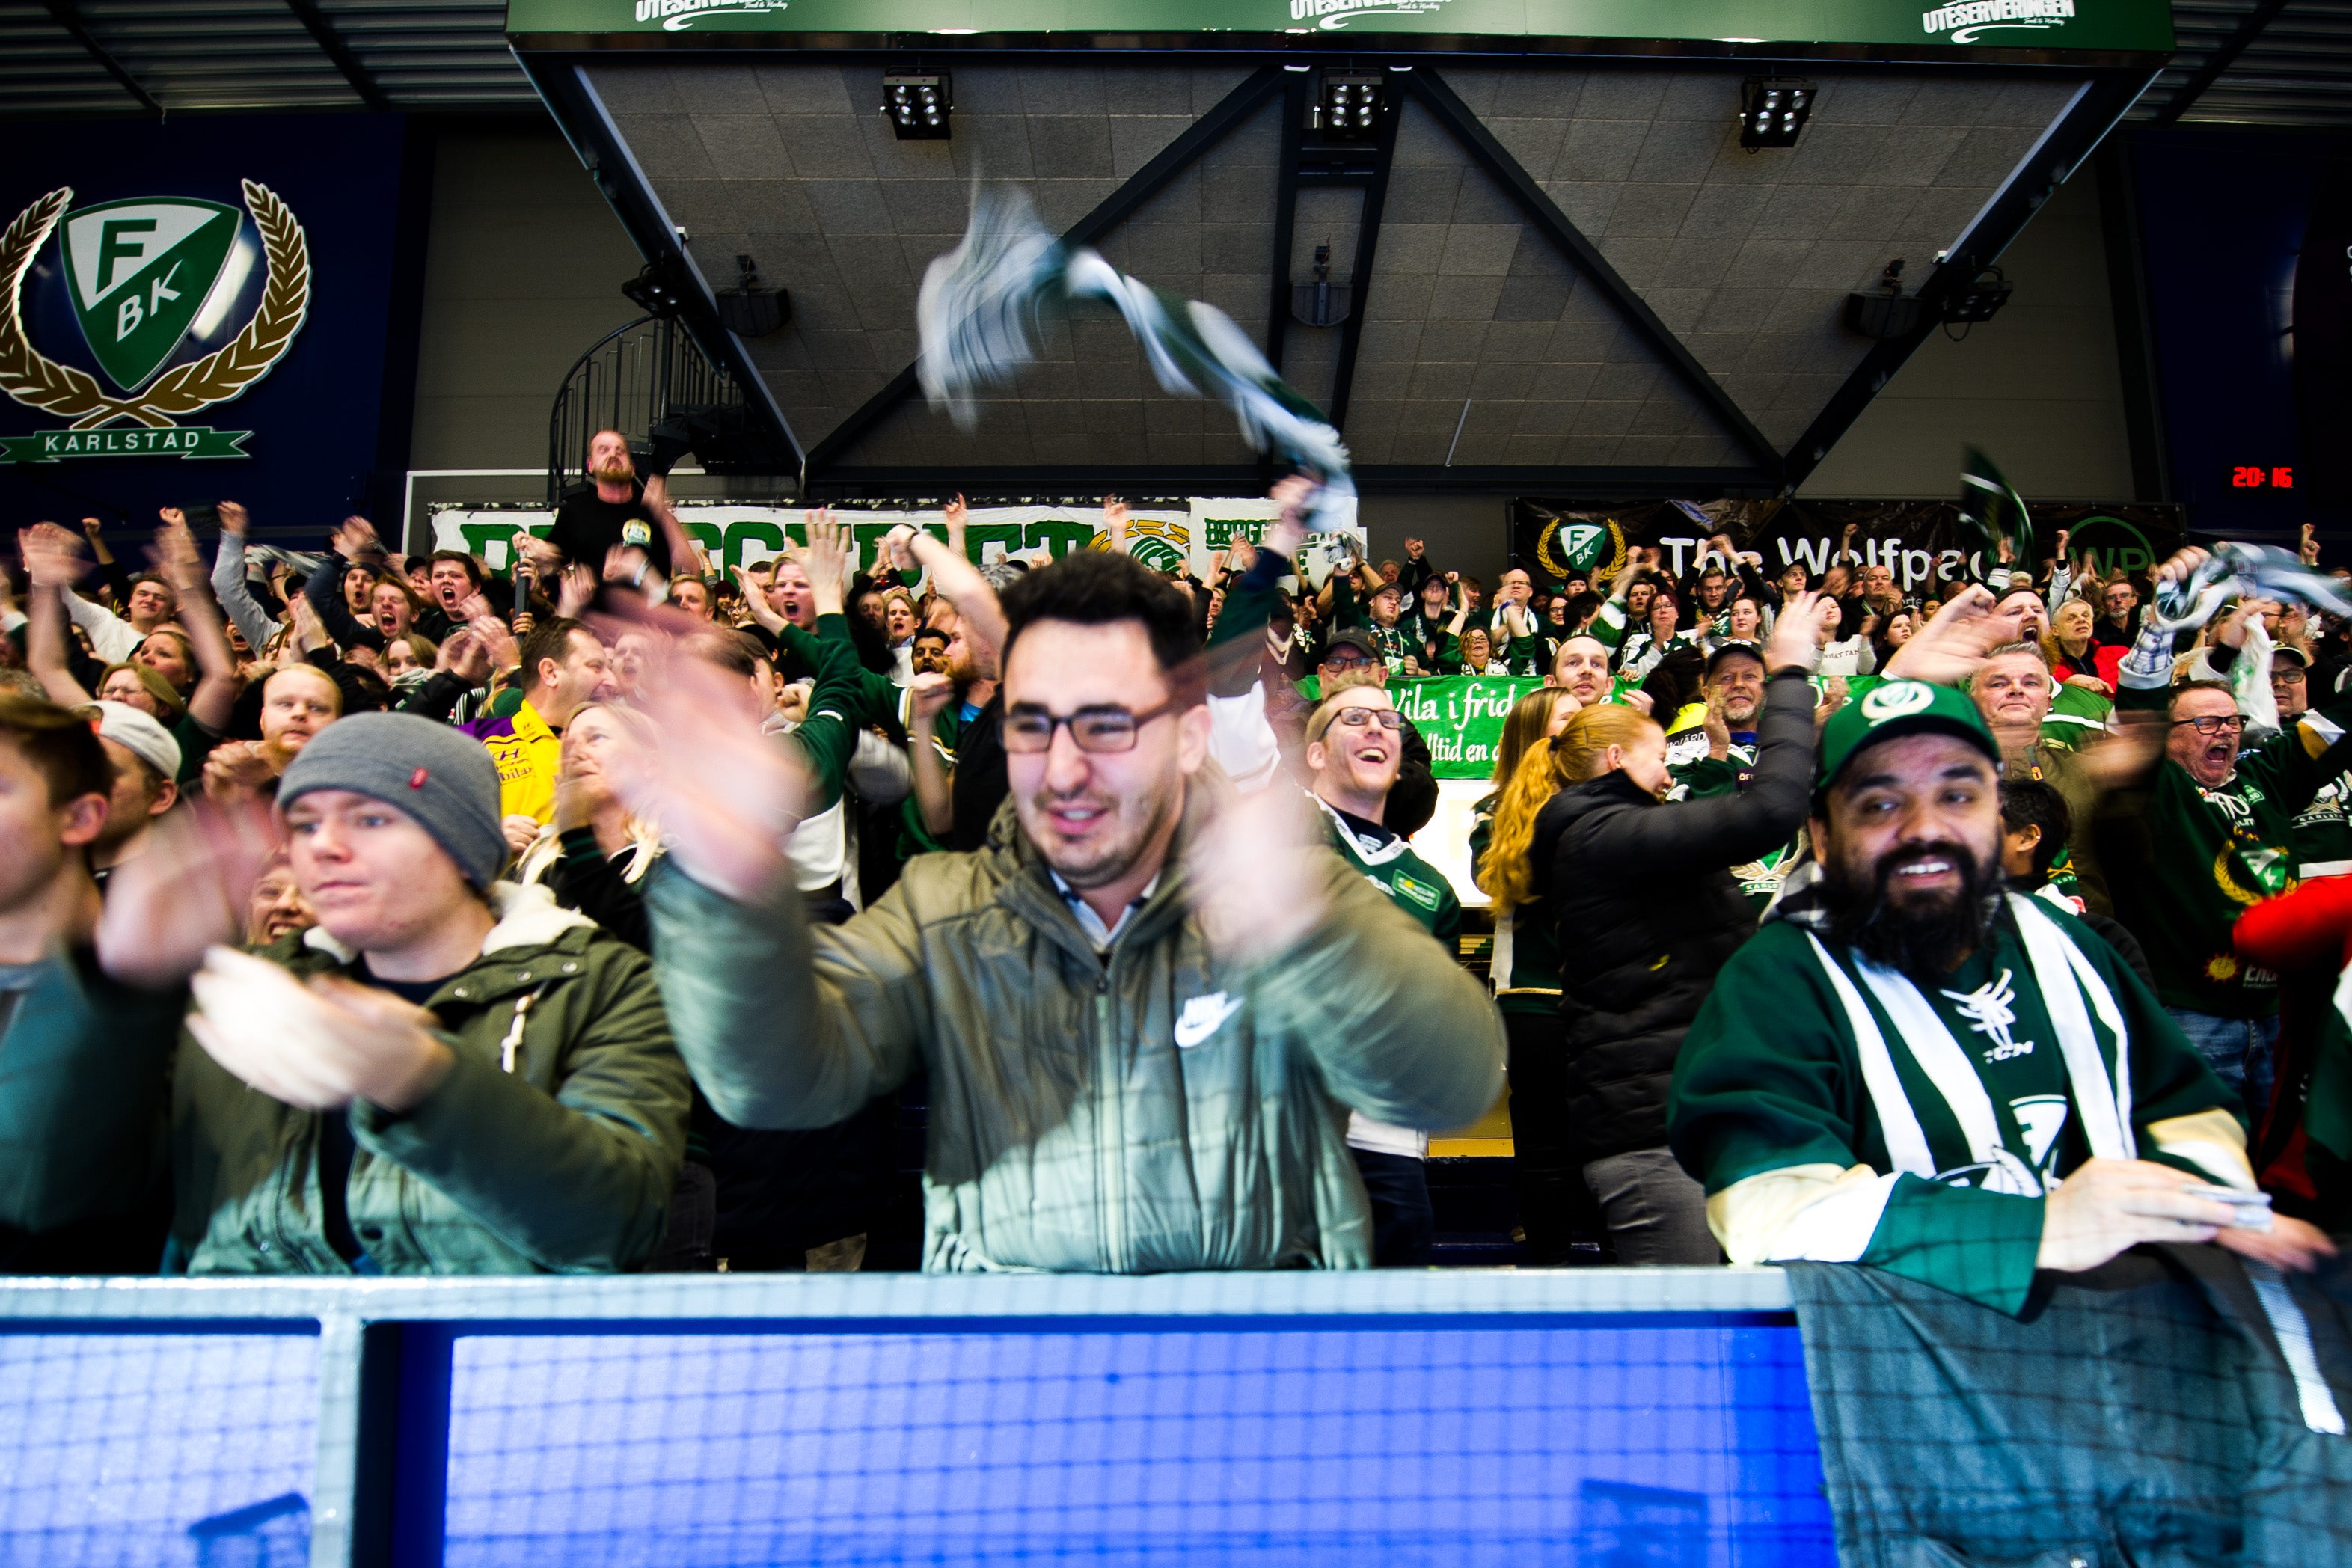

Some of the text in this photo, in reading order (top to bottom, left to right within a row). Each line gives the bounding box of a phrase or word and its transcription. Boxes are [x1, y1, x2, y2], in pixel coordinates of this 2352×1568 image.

[96, 219, 157, 295] F
[45, 432, 200, 452] KARLSTAD
[1384, 683, 1439, 720] Vila
[1448, 692, 1459, 719] i
[1454, 682, 1516, 730] frid
[1466, 744, 1489, 762] en
